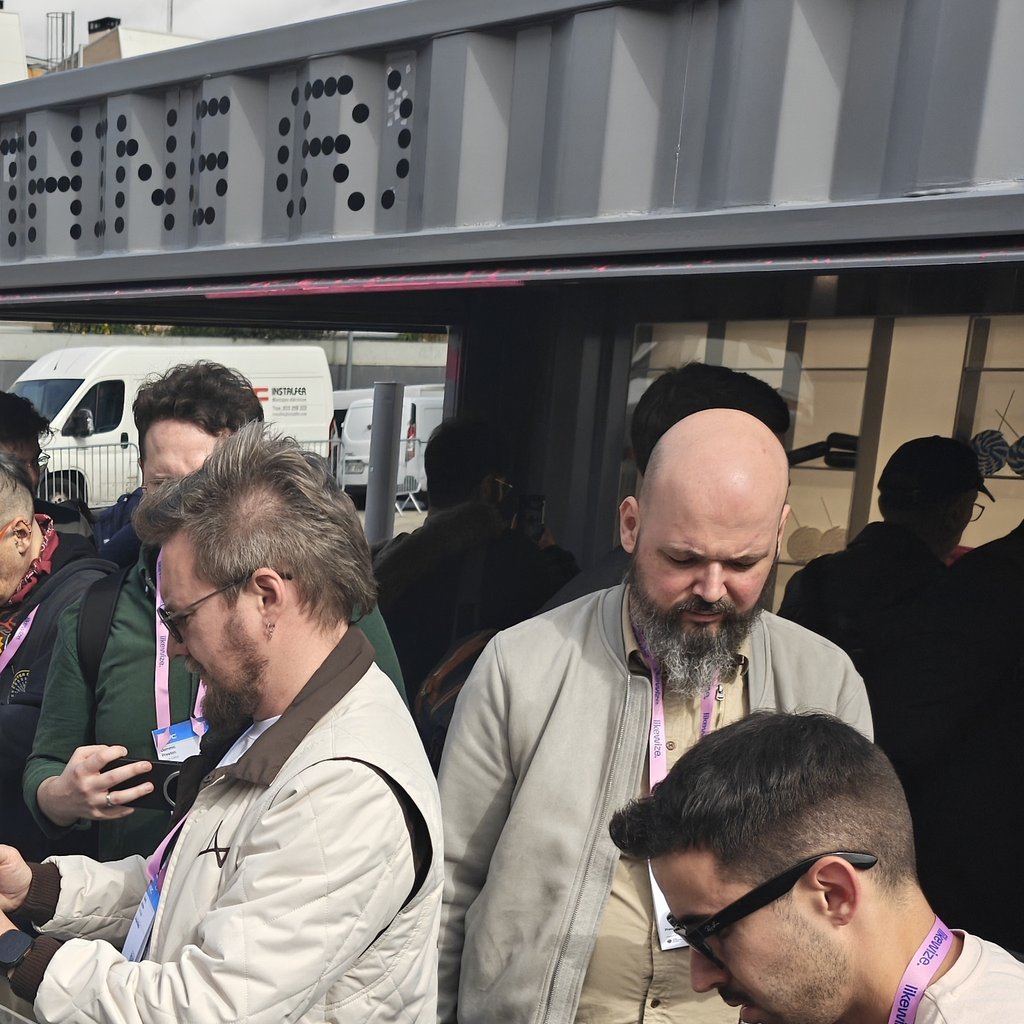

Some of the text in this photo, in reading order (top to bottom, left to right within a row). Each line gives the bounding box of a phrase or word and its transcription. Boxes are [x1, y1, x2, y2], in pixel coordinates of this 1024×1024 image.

[276, 68, 414, 219] (R)
[652, 719, 663, 759] likewize.
[916, 928, 949, 966] likewize.
